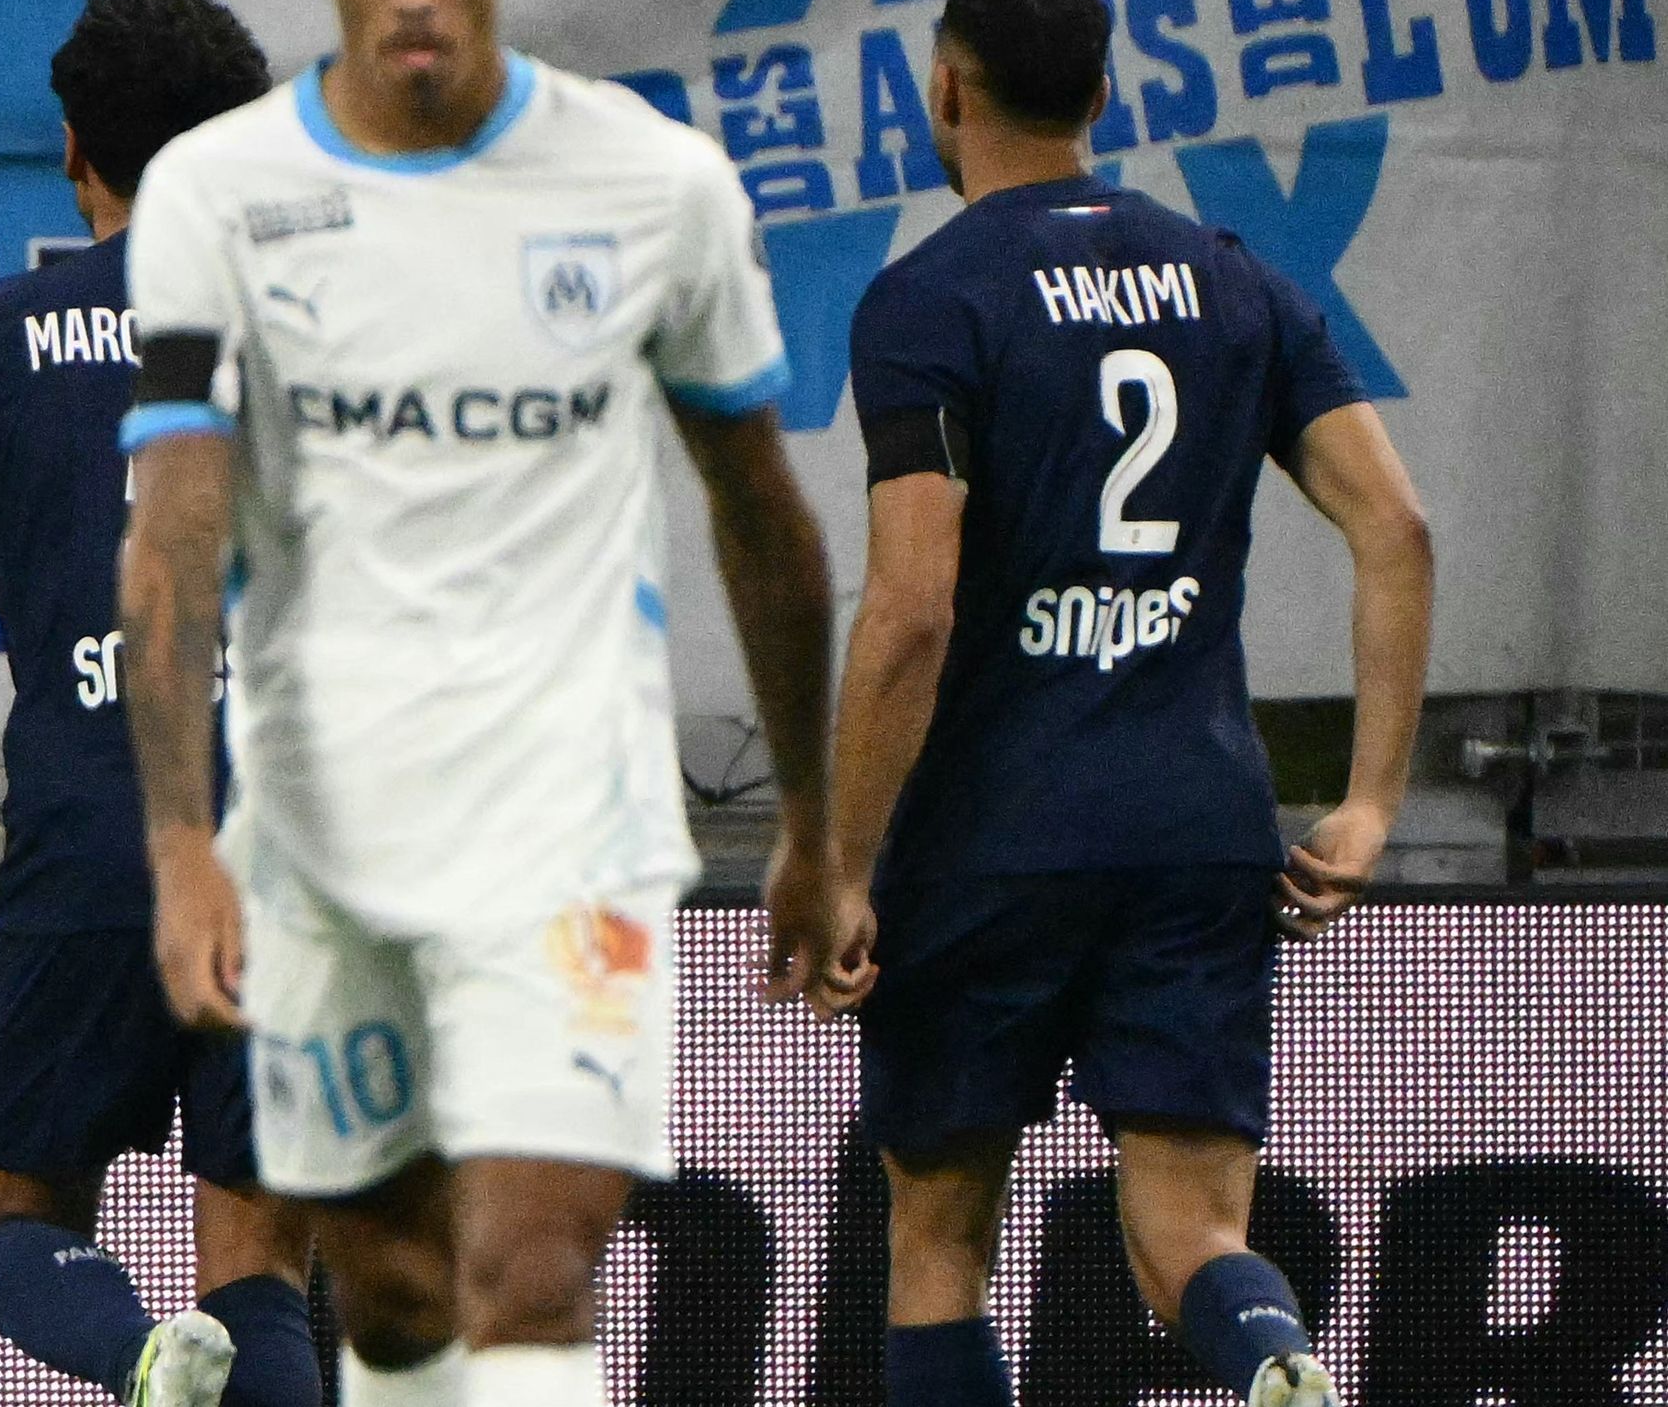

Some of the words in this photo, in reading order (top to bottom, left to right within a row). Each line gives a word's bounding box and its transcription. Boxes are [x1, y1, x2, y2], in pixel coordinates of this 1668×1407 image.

[1033, 263, 1202, 326] HAKIMI
[288, 384, 434, 440] CMA
[453, 381, 610, 442] CGM
[1098, 348, 1181, 553] 2
[1019, 576, 1201, 672] snipes
[301, 1019, 416, 1138] 10
